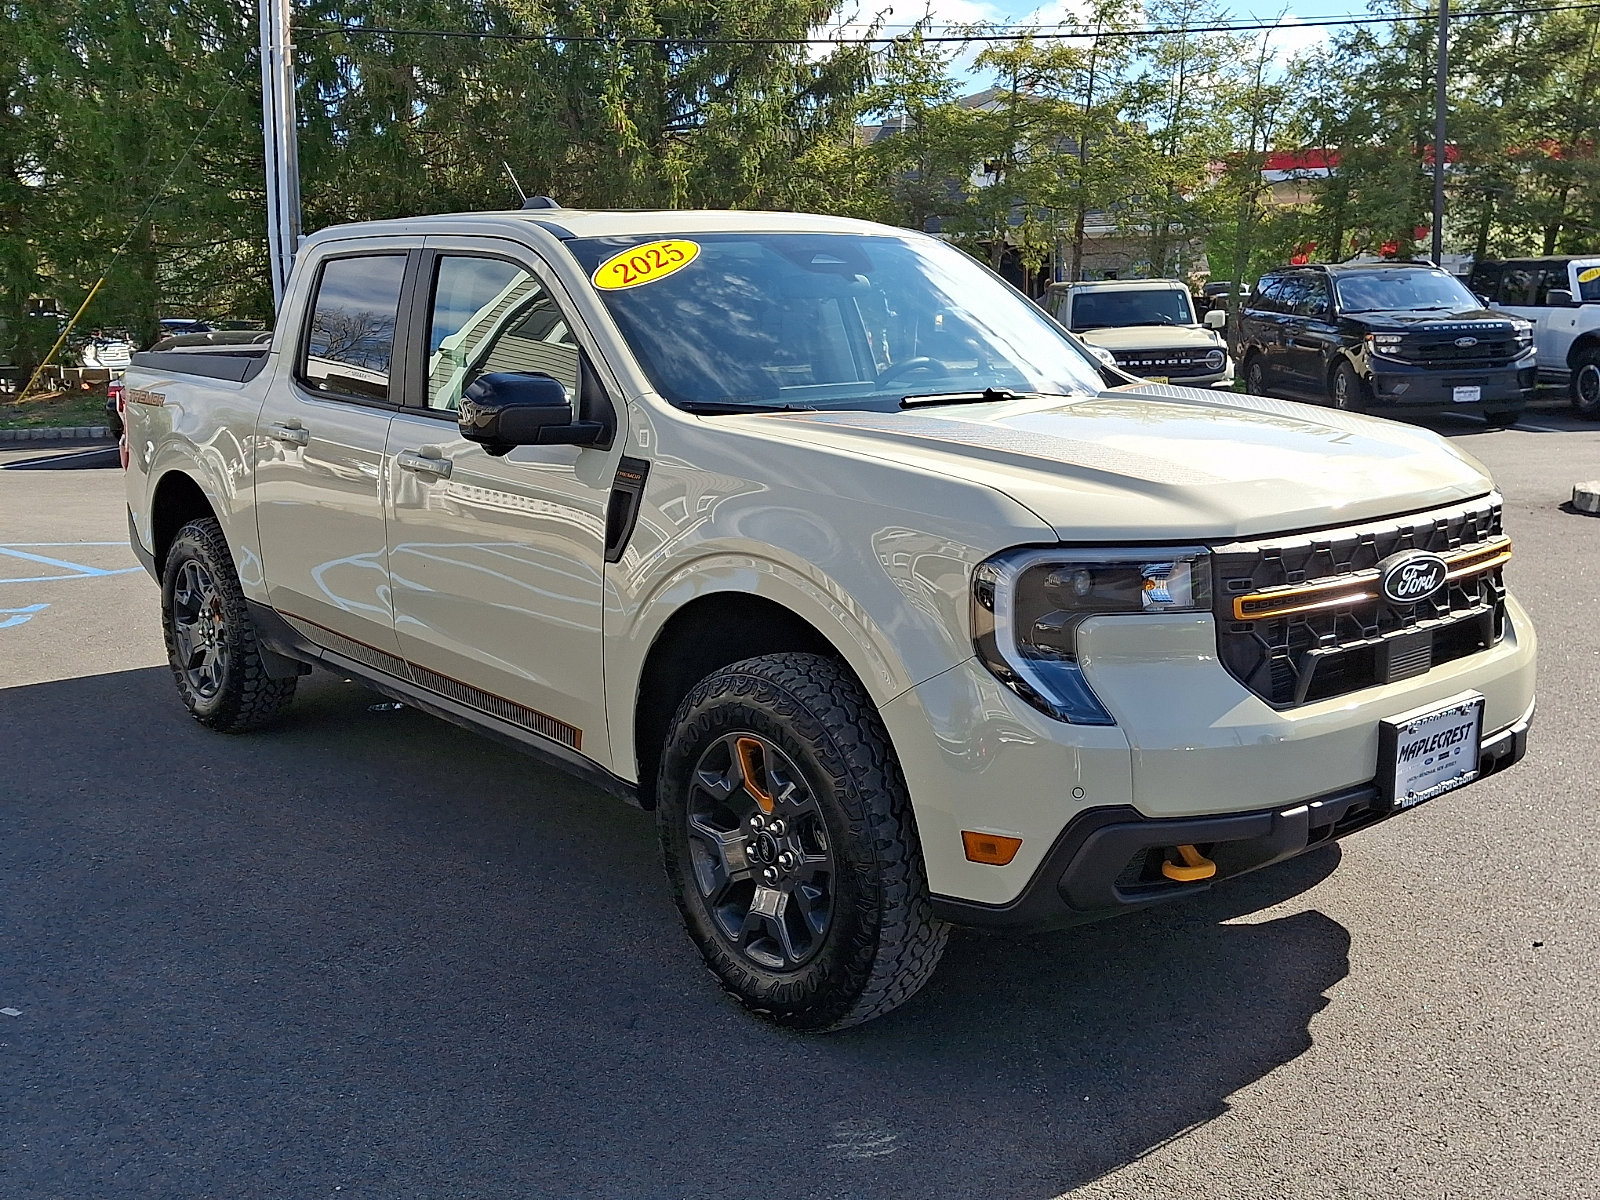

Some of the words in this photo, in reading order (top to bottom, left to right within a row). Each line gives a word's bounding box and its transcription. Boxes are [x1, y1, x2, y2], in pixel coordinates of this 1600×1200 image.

[612, 243, 685, 284] 2025
[1116, 358, 1191, 366] BRONCO
[129, 389, 166, 407] TREMOR
[1397, 562, 1438, 596] Ford
[1397, 721, 1474, 765] MAPLECREST
